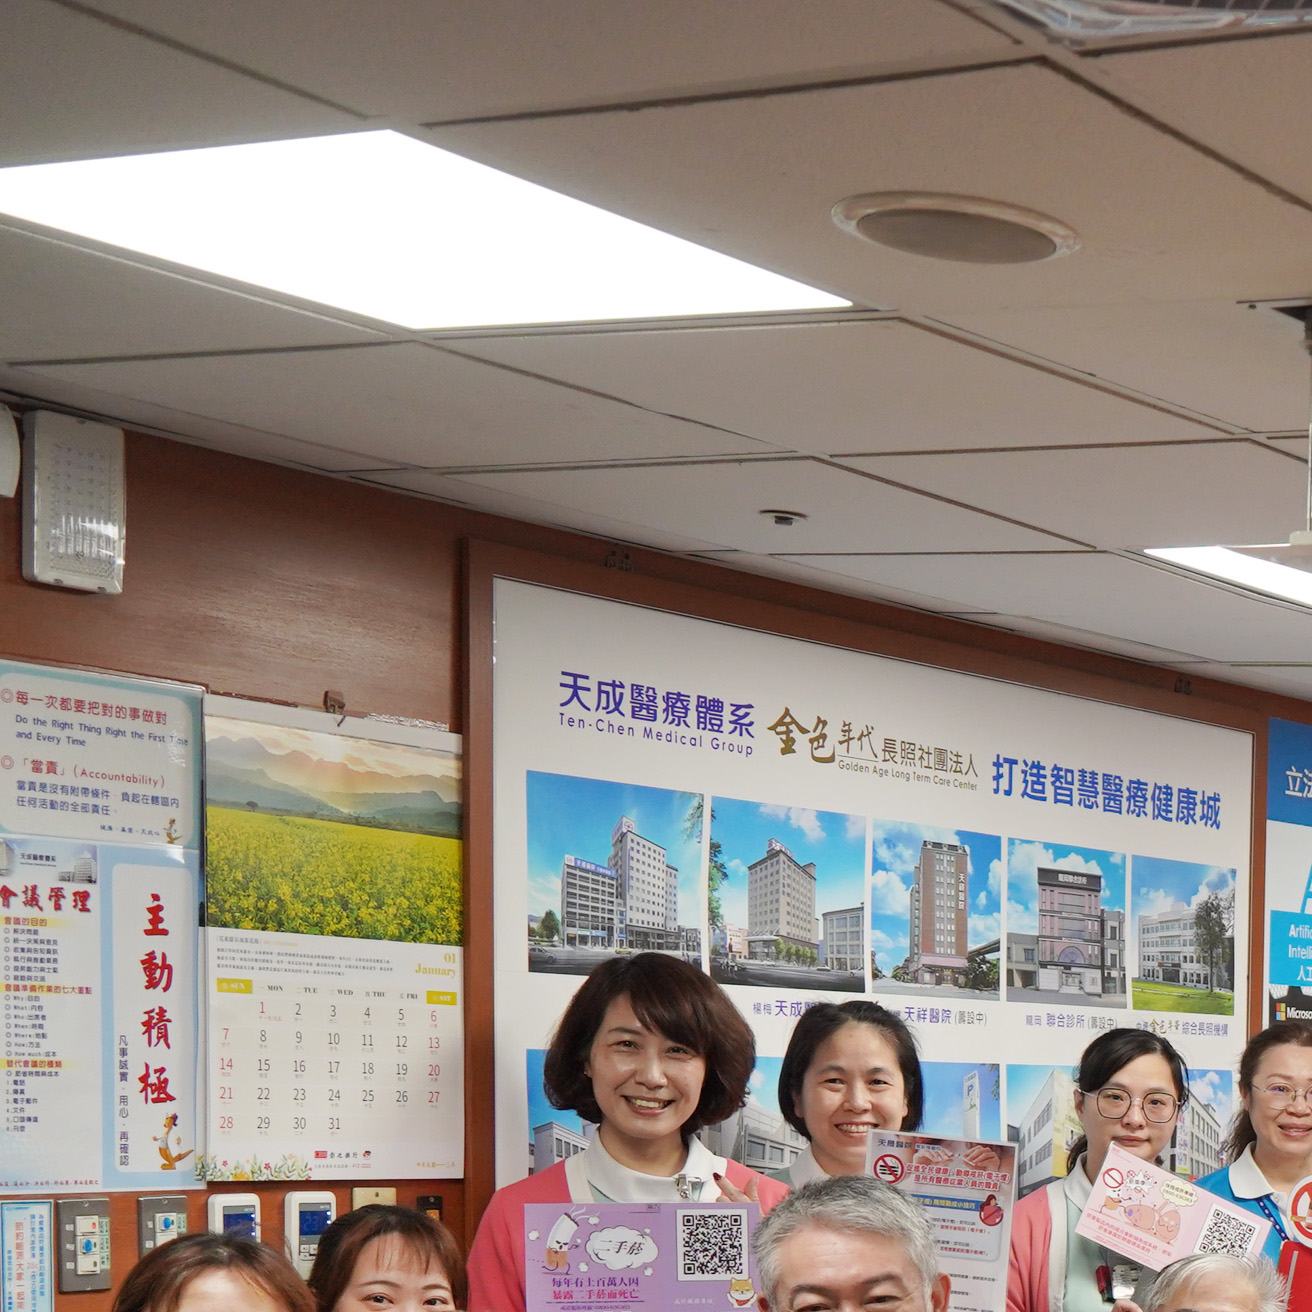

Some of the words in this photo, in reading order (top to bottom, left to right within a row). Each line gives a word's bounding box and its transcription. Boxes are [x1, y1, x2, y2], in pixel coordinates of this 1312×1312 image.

[15, 690, 168, 726] 每一次都要把對的事做對
[559, 671, 755, 738] 天成醫療體系
[16, 715, 28, 724] Do
[33, 717, 47, 727] the
[52, 720, 74, 731] Right
[79, 723, 102, 736] Thing
[106, 726, 127, 739] Right
[131, 730, 145, 740] the
[149, 732, 165, 743] First
[559, 712, 635, 737] Ten-Chen
[642, 726, 703, 747] Medical
[710, 738, 753, 757] Group
[16, 731, 32, 740] and
[36, 733, 61, 745] Every
[67, 736, 86, 747] Time
[838, 759, 870, 774] Golden
[872, 765, 889, 777] Age
[892, 768, 910, 782] Long
[913, 772, 931, 784] Term
[933, 776, 951, 787] Care
[953, 779, 978, 791] Center
[992, 754, 1221, 830] 打造智慧醫療健康城
[0, 884, 92, 913] 會議管理
[4, 916, 48, 927] 會議的目的
[414, 963, 456, 978] January
[138, 893, 177, 1105] 主動積極
[904, 1006, 952, 1025] 天祥醫院
[1046, 1012, 1085, 1029] 聯合診所
[429, 1037, 440, 1049] 13
[220, 1058, 233, 1070] 14
[258, 1059, 270, 1071] 15
[293, 1060, 305, 1072] 16
[329, 1062, 340, 1073] 17
[362, 1063, 374, 1074] 18
[396, 1064, 408, 1075] 19
[428, 1065, 440, 1076] 20
[220, 1087, 233, 1099] 21
[257, 1088, 270, 1100] 22
[293, 1089, 306, 1100] 23
[328, 1090, 340, 1101] 24
[362, 1090, 374, 1102] 25
[396, 1091, 408, 1102] 26
[428, 1092, 440, 1103] 27
[220, 1117, 233, 1129] 28
[257, 1117, 270, 1129] 29
[293, 1118, 306, 1129] 30
[328, 1118, 340, 1129] 31
[552, 1276, 640, 1288] 每年有上百萬人因
[552, 1289, 640, 1300] 暴露二手菸而死亡
